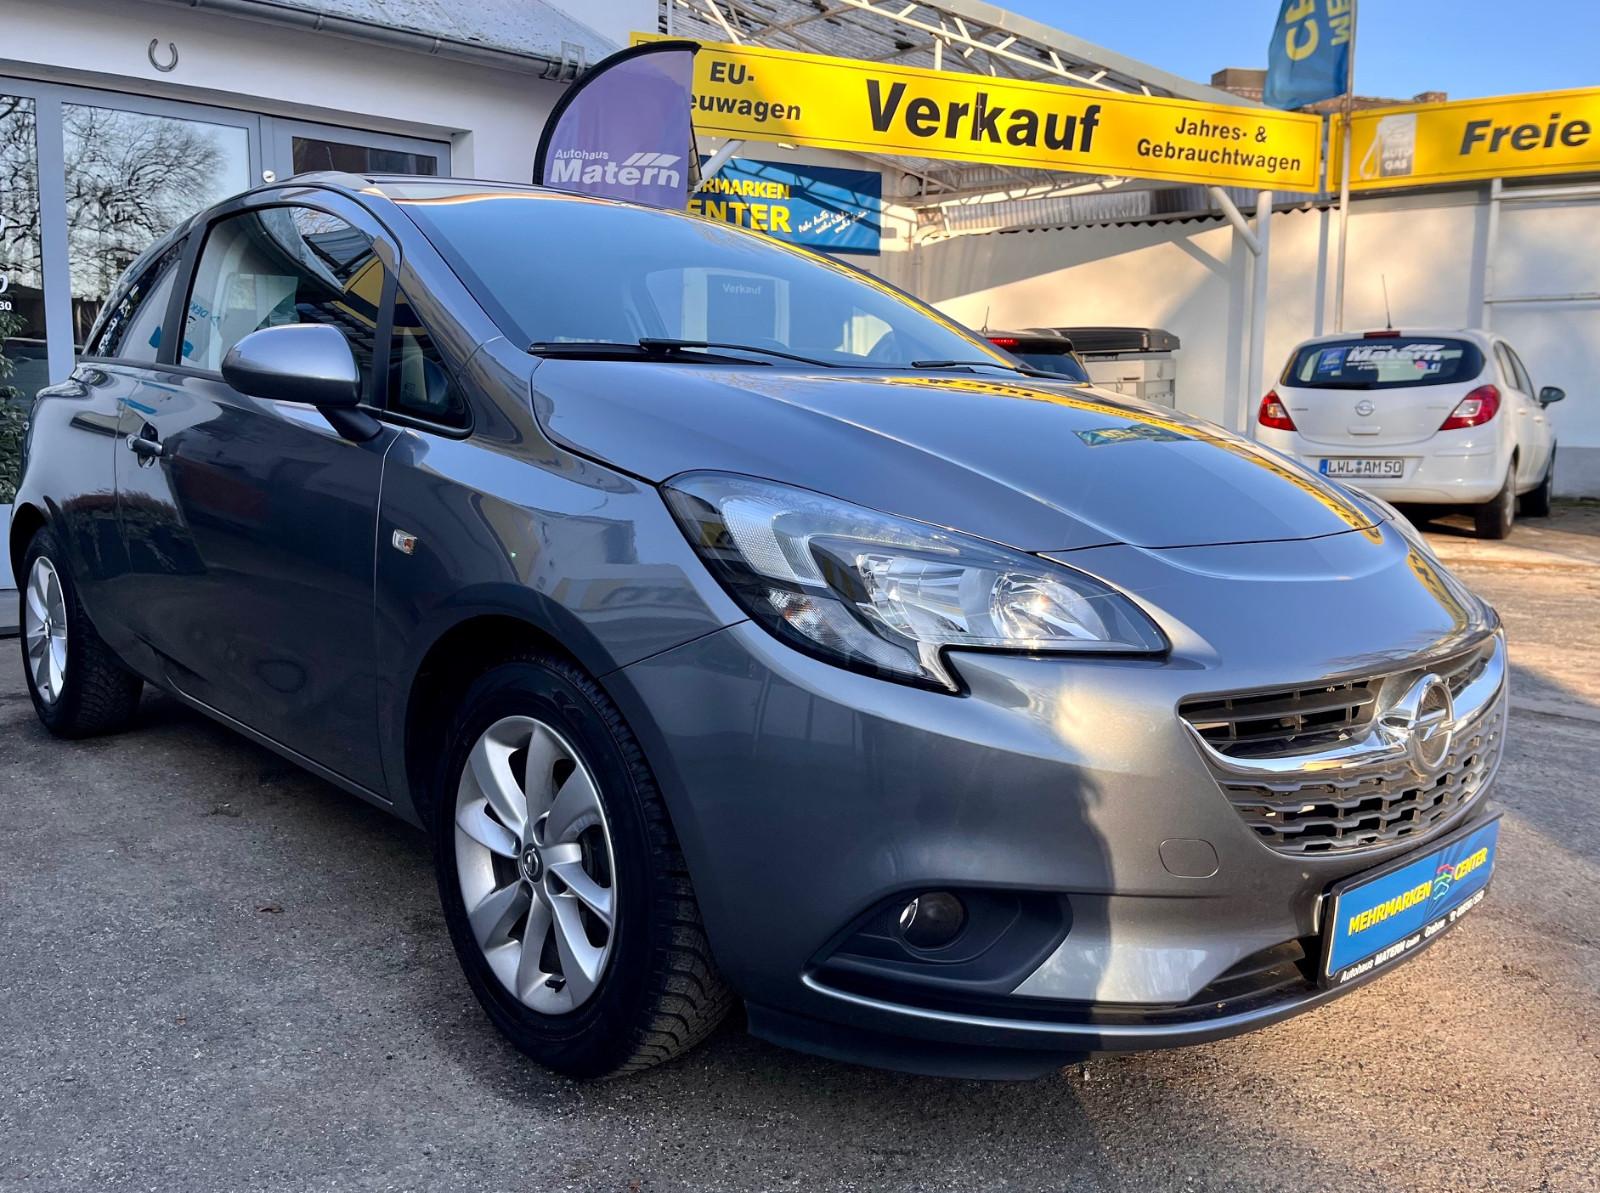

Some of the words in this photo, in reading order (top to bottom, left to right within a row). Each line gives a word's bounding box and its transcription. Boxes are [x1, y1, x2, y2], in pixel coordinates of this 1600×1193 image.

[710, 61, 755, 85] EU-
[866, 79, 1101, 153] Verkauf
[1175, 117, 1247, 141] Jahres-
[1255, 125, 1267, 143] &
[1459, 112, 1592, 156] Freie
[555, 149, 609, 160] Autohaus
[1137, 138, 1301, 173] Gebrauchtwagen
[550, 158, 681, 188] Matern
[722, 282, 761, 296] Verkauf
[1328, 459, 1355, 474] LWL
[1364, 459, 1382, 474] AM
[1384, 460, 1402, 474] 50
[1348, 880, 1433, 936] MEHRMARKEN
[1454, 848, 1488, 881] CENTER
[1340, 959, 1374, 984] Autohaus
[1374, 940, 1406, 966] MATERN
